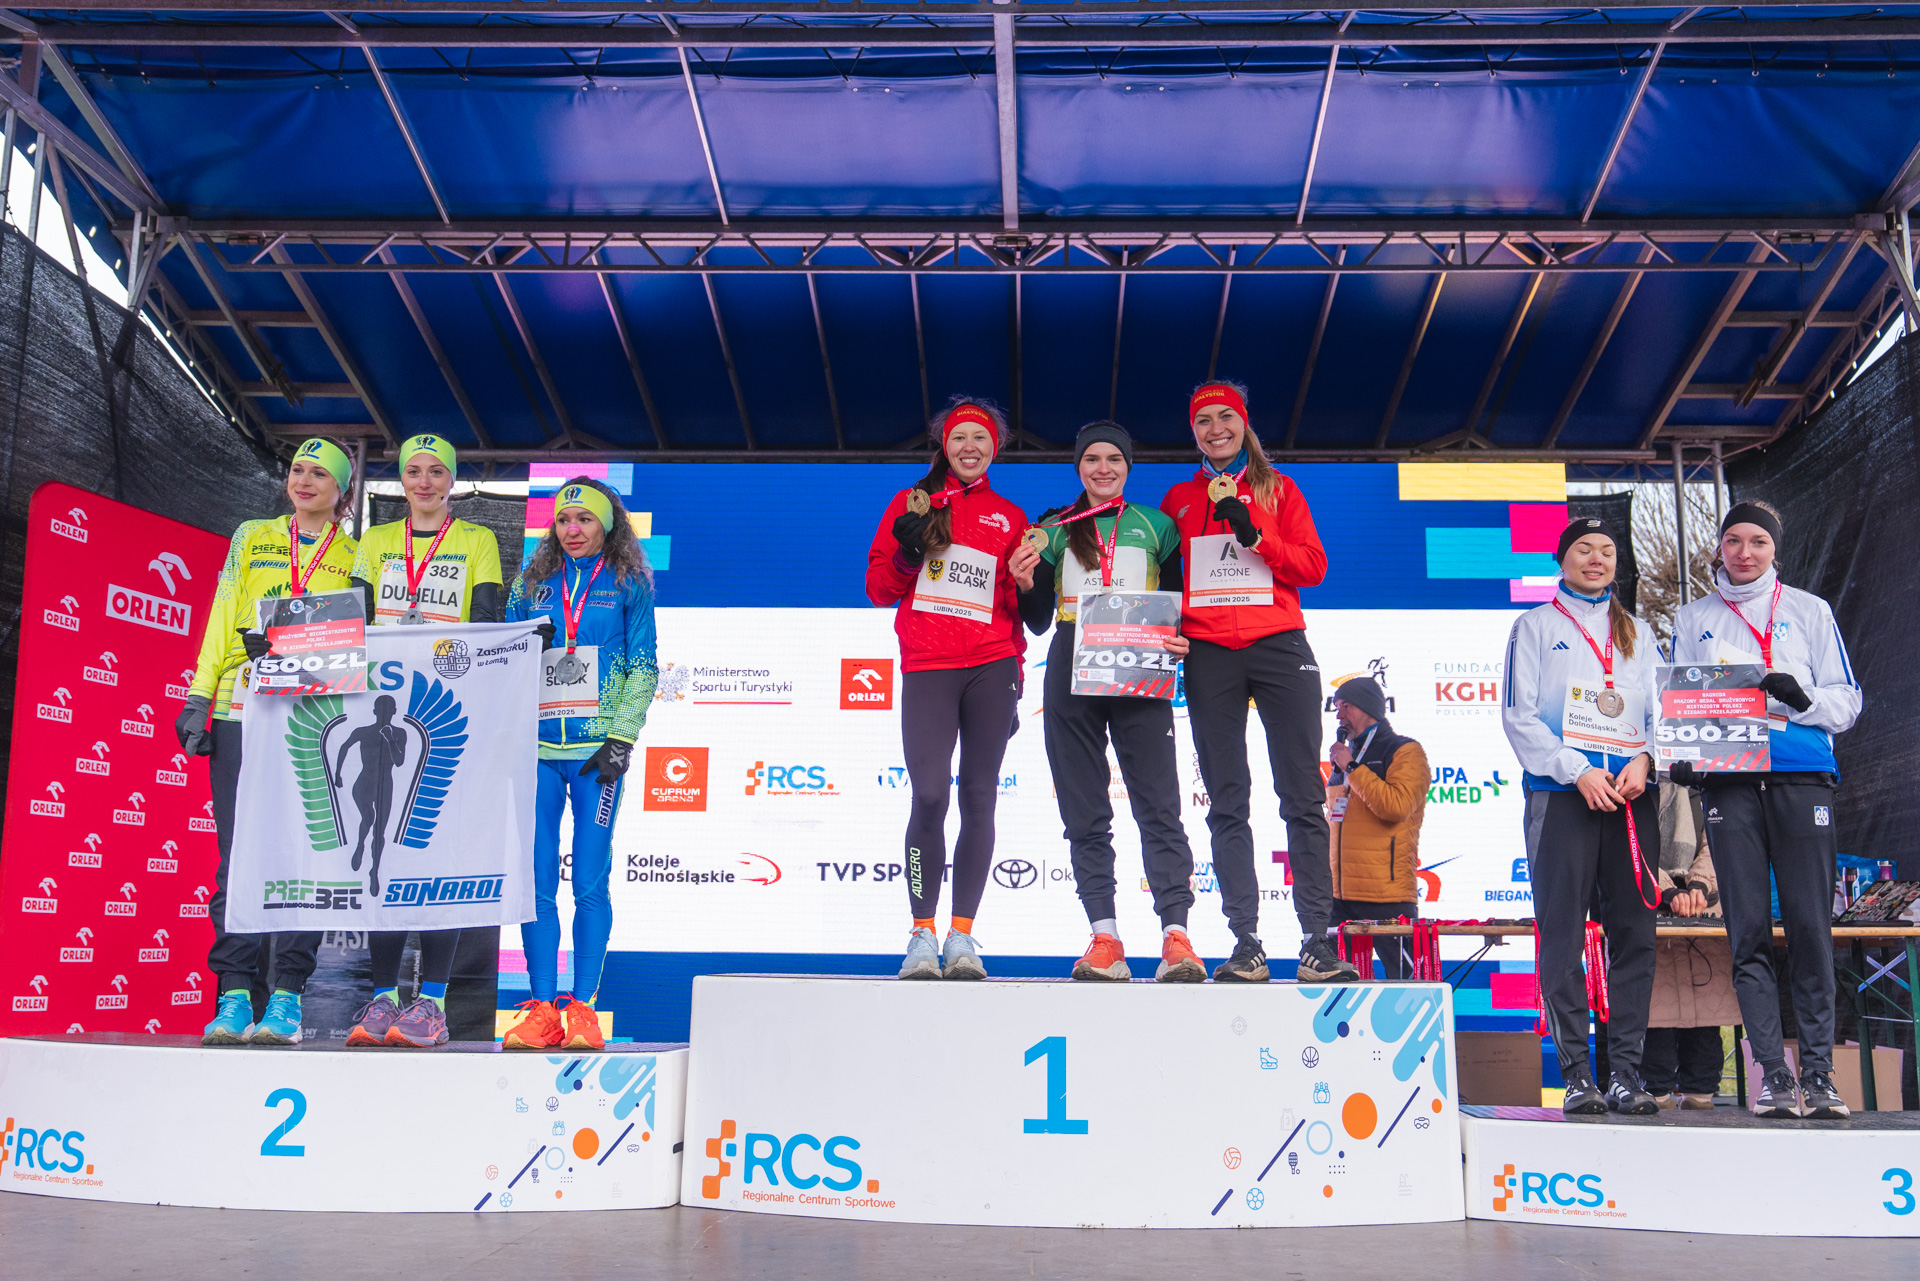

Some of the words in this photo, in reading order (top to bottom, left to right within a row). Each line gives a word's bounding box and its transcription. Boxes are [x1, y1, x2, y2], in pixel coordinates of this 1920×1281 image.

[53, 521, 86, 541] ORLEN
[318, 562, 351, 579] KGH
[429, 566, 459, 580] 382
[950, 561, 990, 580] DOLNY
[1210, 568, 1250, 577] ASTONE
[948, 570, 987, 590] ŚLĄSK
[1084, 577, 1125, 586] ASTNE
[112, 591, 186, 630] ORLEN
[933, 605, 953, 613] LUBIN
[954, 608, 972, 616] 2025
[46, 612, 77, 629] ORLEN
[476, 639, 528, 657] Zasmakuj
[259, 655, 324, 673] 500
[329, 652, 366, 670] ZŁ
[1079, 650, 1137, 667] 700
[1142, 652, 1176, 671] ZŁ
[693, 667, 770, 677] Ministerstwo
[1434, 662, 1503, 674] FUNDAC
[86, 669, 116, 684] ORLEN
[167, 687, 188, 698] ORLE
[692, 681, 731, 693] Sportu
[740, 681, 792, 694] Turystyki
[1435, 682, 1497, 702] KGH
[848, 693, 885, 702] ORLEN
[39, 707, 70, 721] ORLEN
[1568, 712, 1593, 723] Koleje
[124, 722, 152, 735] ORLEN
[1568, 719, 1618, 733] Dolnośląskie
[1656, 724, 1722, 742] 500
[1727, 724, 1769, 742] ZŁ
[1583, 742, 1605, 750] LUBIN
[1606, 745, 1623, 754] 2025
[78, 761, 108, 774] ORLEN
[158, 773, 186, 784] ORLEN
[1430, 767, 1468, 784] UPA
[651, 788, 700, 796] CUPRUM
[33, 802, 63, 815] ORLEN
[115, 812, 143, 824] ORLEN
[191, 820, 216, 831] ORLEN
[71, 854, 100, 866] ORLEN
[149, 860, 176, 871] ORLEN
[627, 854, 680, 869] Koleje
[627, 869, 735, 885] Dolnośląskie
[817, 863, 866, 881] TVP
[873, 863, 952, 882] SPT
[910, 846, 923, 900] ADIZERO
[384, 876, 504, 907] SONAROL
[1485, 890, 1533, 902] BIEGAN
[24, 900, 55, 911] ORLEN
[107, 903, 135, 914] ORLEN
[182, 906, 208, 916] ORLEN
[62, 950, 91, 960] ORLEN
[141, 950, 167, 960] ORLEN
[15, 998, 46, 1009] ORLEN
[98, 997, 126, 1007] ORLEN
[173, 992, 200, 1003] ORLEN
[1023, 1036, 1089, 1135] 1
[260, 1088, 308, 1158] 2
[13, 1171, 43, 1181] Regionalne
[45, 1174, 70, 1184] Centrum
[72, 1177, 104, 1187] Sportowe
[1881, 1168, 1916, 1215] 3
[742, 1190, 794, 1203] Regionalne
[799, 1193, 841, 1206] Centrum
[845, 1196, 896, 1209] Sportowe
[1522, 1206, 1560, 1215] Regionalne
[1562, 1208, 1591, 1216] Centrum
[1593, 1210, 1628, 1218] Sportowe
